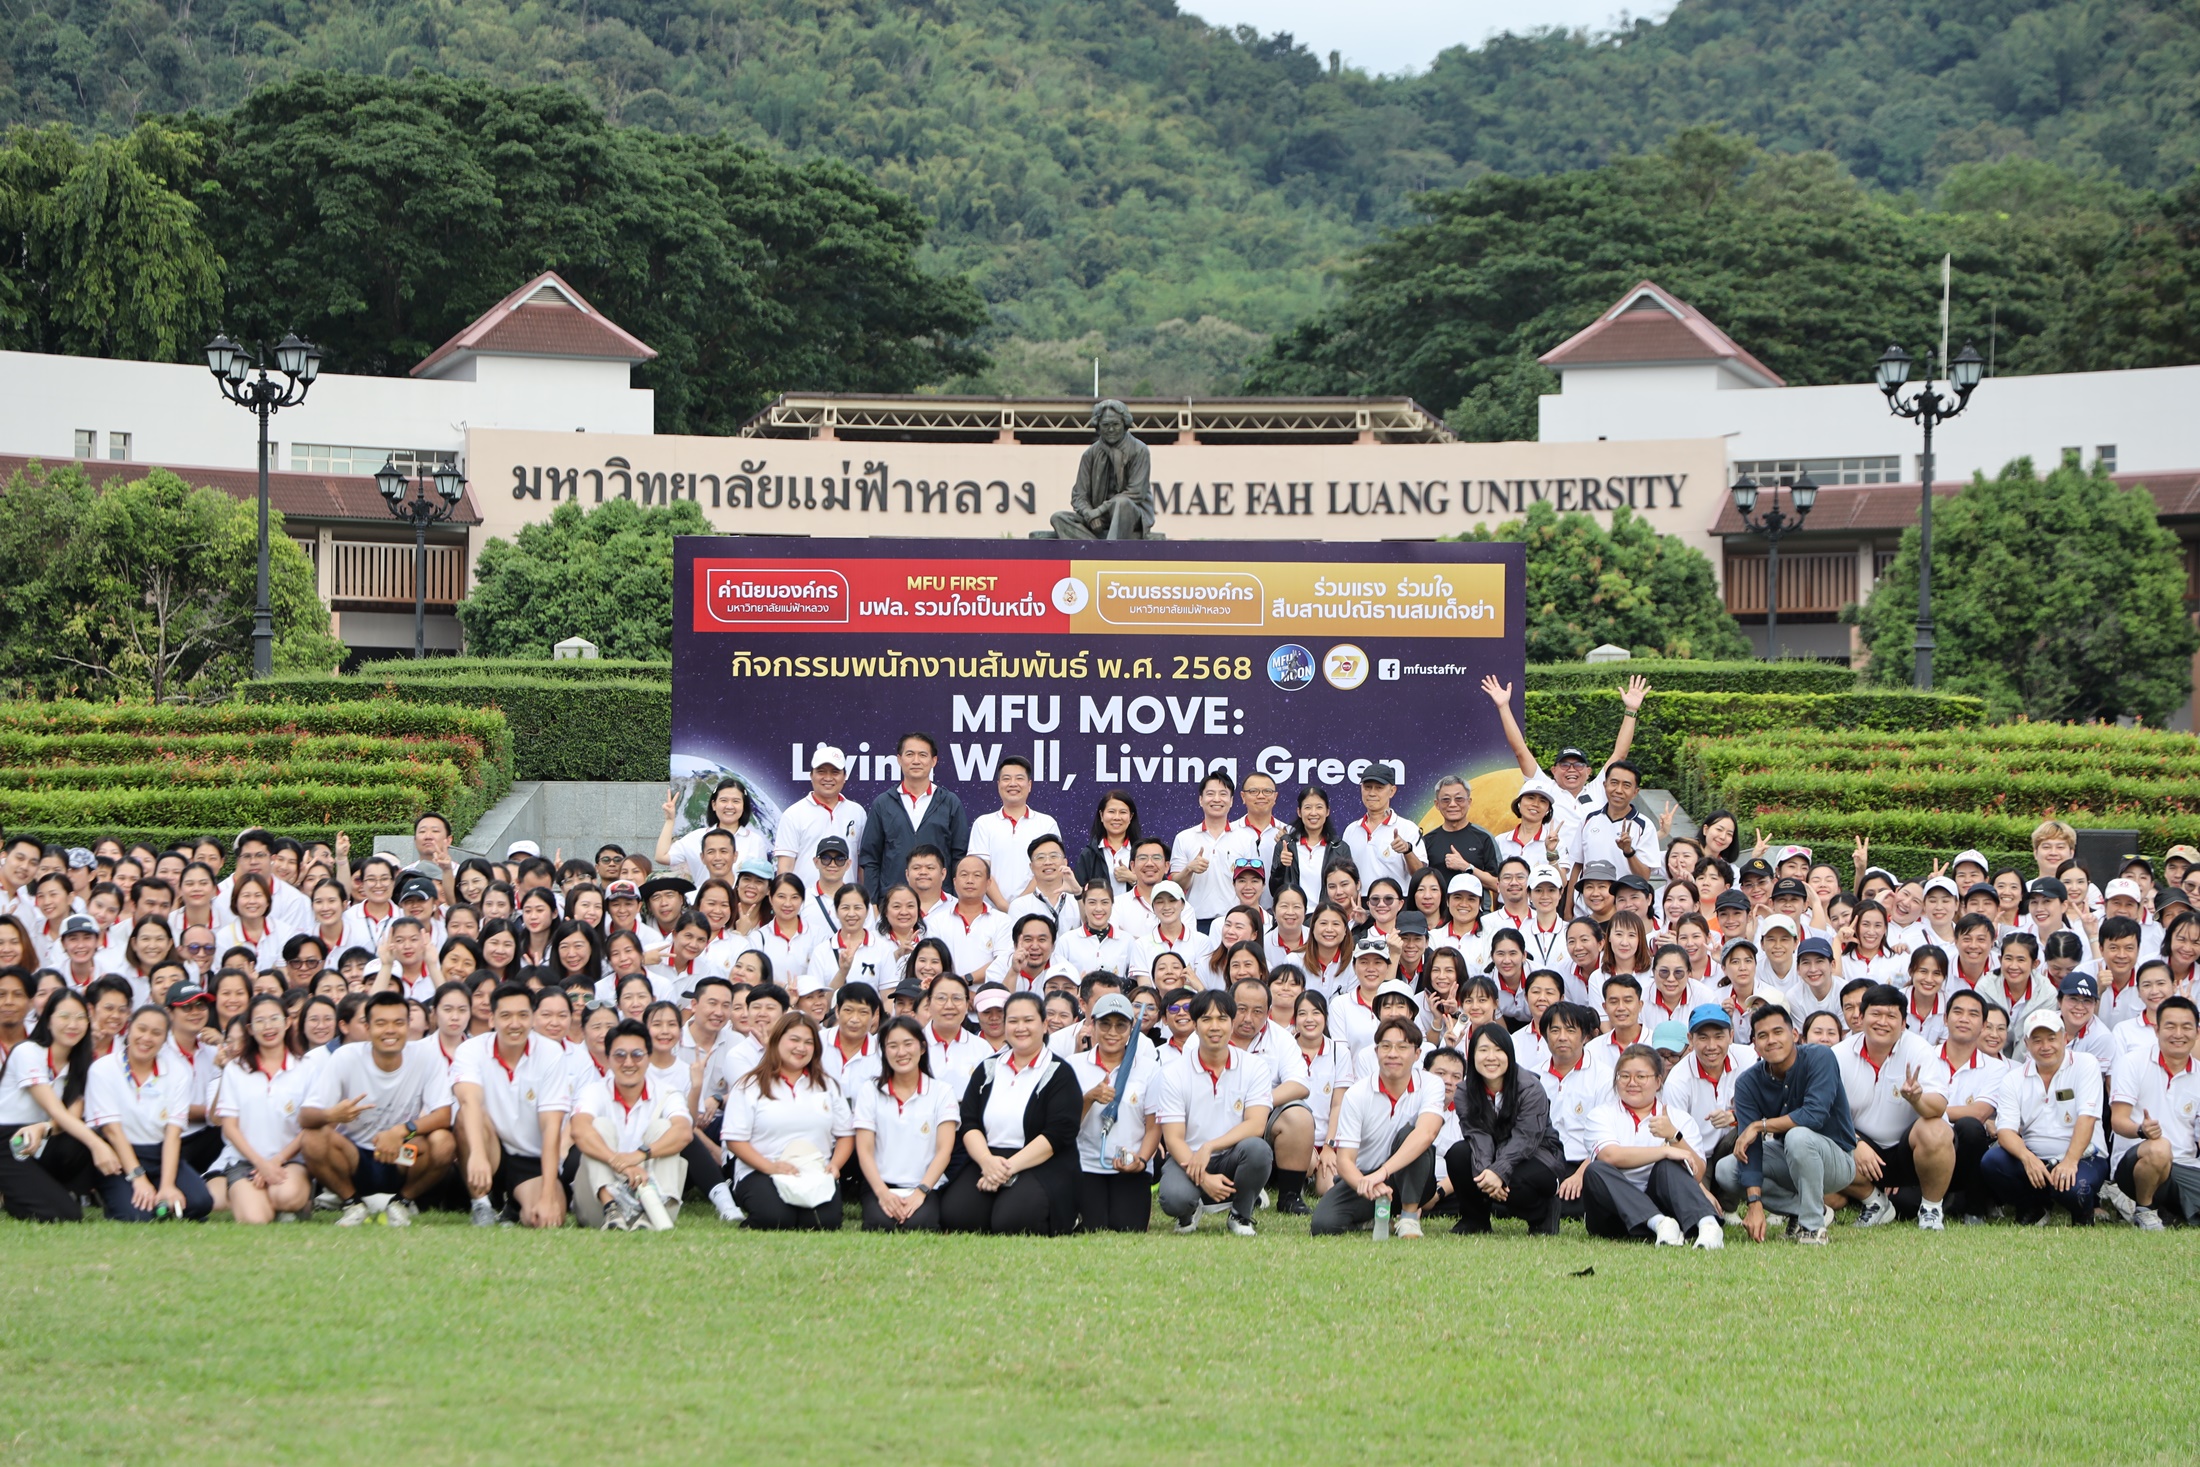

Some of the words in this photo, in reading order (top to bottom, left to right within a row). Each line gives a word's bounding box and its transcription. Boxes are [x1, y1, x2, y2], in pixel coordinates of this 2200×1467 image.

[511, 456, 1037, 515] มหาวิทยาลัยแม่ฟ้าหลวง
[1151, 480, 1235, 516] MAE
[1244, 482, 1312, 516] FAH
[1326, 480, 1449, 516] LUANG
[1461, 473, 1689, 514] UNIVERSITY
[717, 579, 839, 599] ค่านิยมองค์กร
[906, 576, 946, 591] MFU
[950, 576, 998, 591] FIRST
[1106, 581, 1254, 600] วัฒนธรรมองค์กร
[1314, 576, 1387, 597] ร่วมแรง
[1397, 574, 1453, 598] ร่วมใจ
[726, 602, 830, 613] มหาวิทยาลัยแม่ฟ้าหลวง
[859, 597, 909, 616] มฟล.
[914, 592, 1046, 617] รวมใจเป็นหนึ่ง
[1129, 604, 1231, 615] มหาวิทยาลัยแม่ฟ้าหลวง
[1272, 597, 1495, 620] สืบสานปณิธานสมเด็จย่า
[731, 650, 1089, 678] กิจกรรมพนักงานสัมพันธ์
[1097, 656, 1162, 679] พ.ศ.
[1171, 655, 1252, 681] 2568
[1403, 663, 1467, 675] mfustaffvr
[952, 694, 1061, 733] MFU
[1079, 695, 1245, 735] MOVE:
[949, 739, 1077, 791] Wll,
